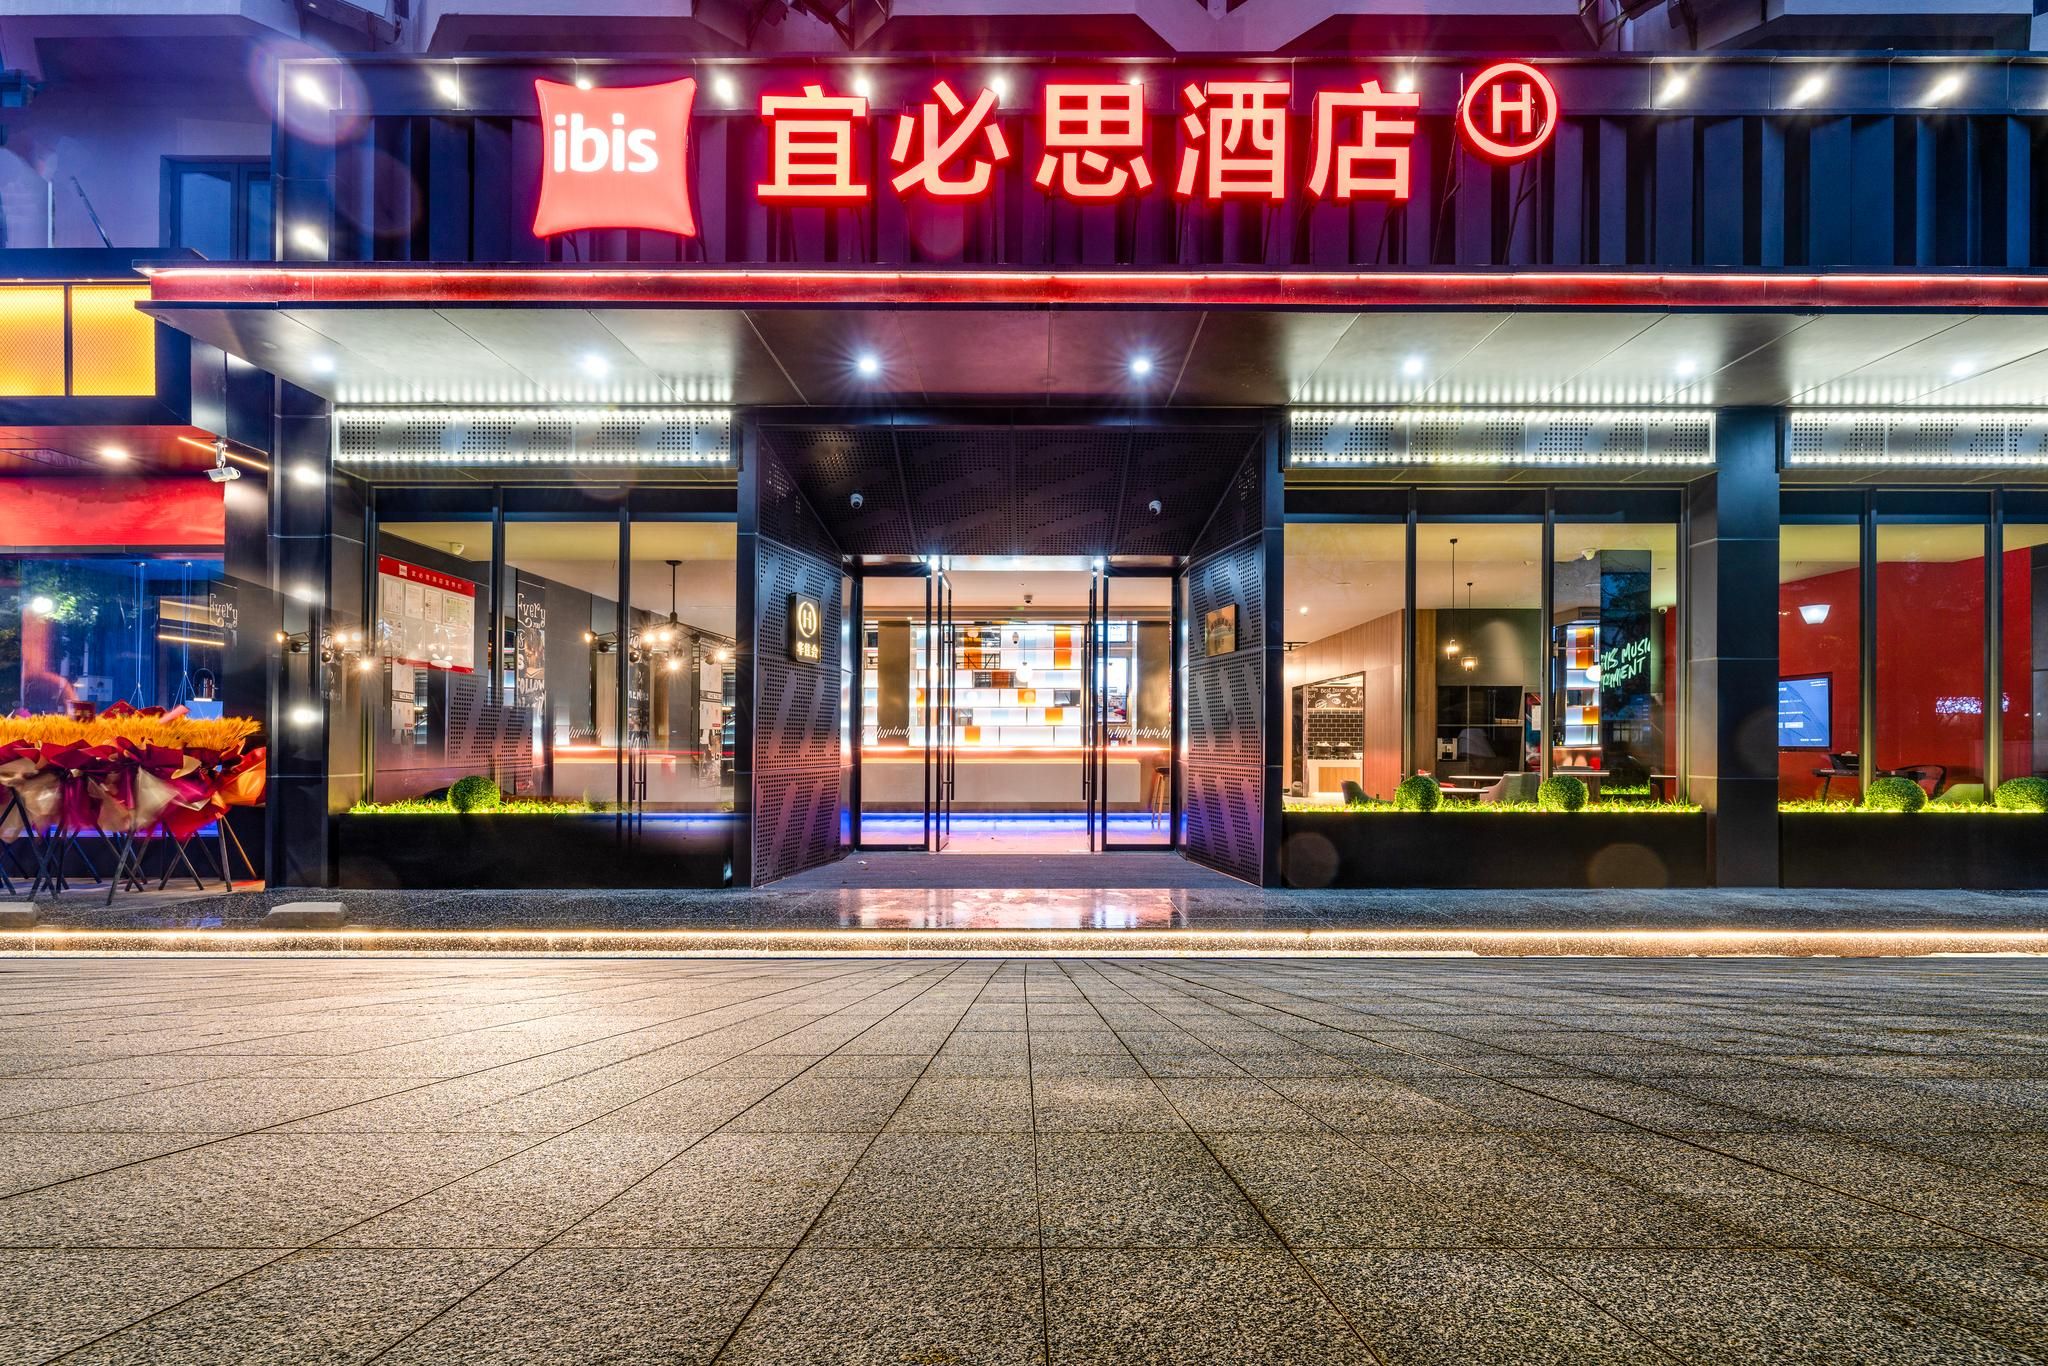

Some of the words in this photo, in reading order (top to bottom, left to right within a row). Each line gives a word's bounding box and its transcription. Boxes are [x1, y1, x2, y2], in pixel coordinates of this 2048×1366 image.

[1492, 84, 1533, 134] H
[553, 112, 659, 174] ibis
[757, 80, 1421, 201] 宜必思酒店
